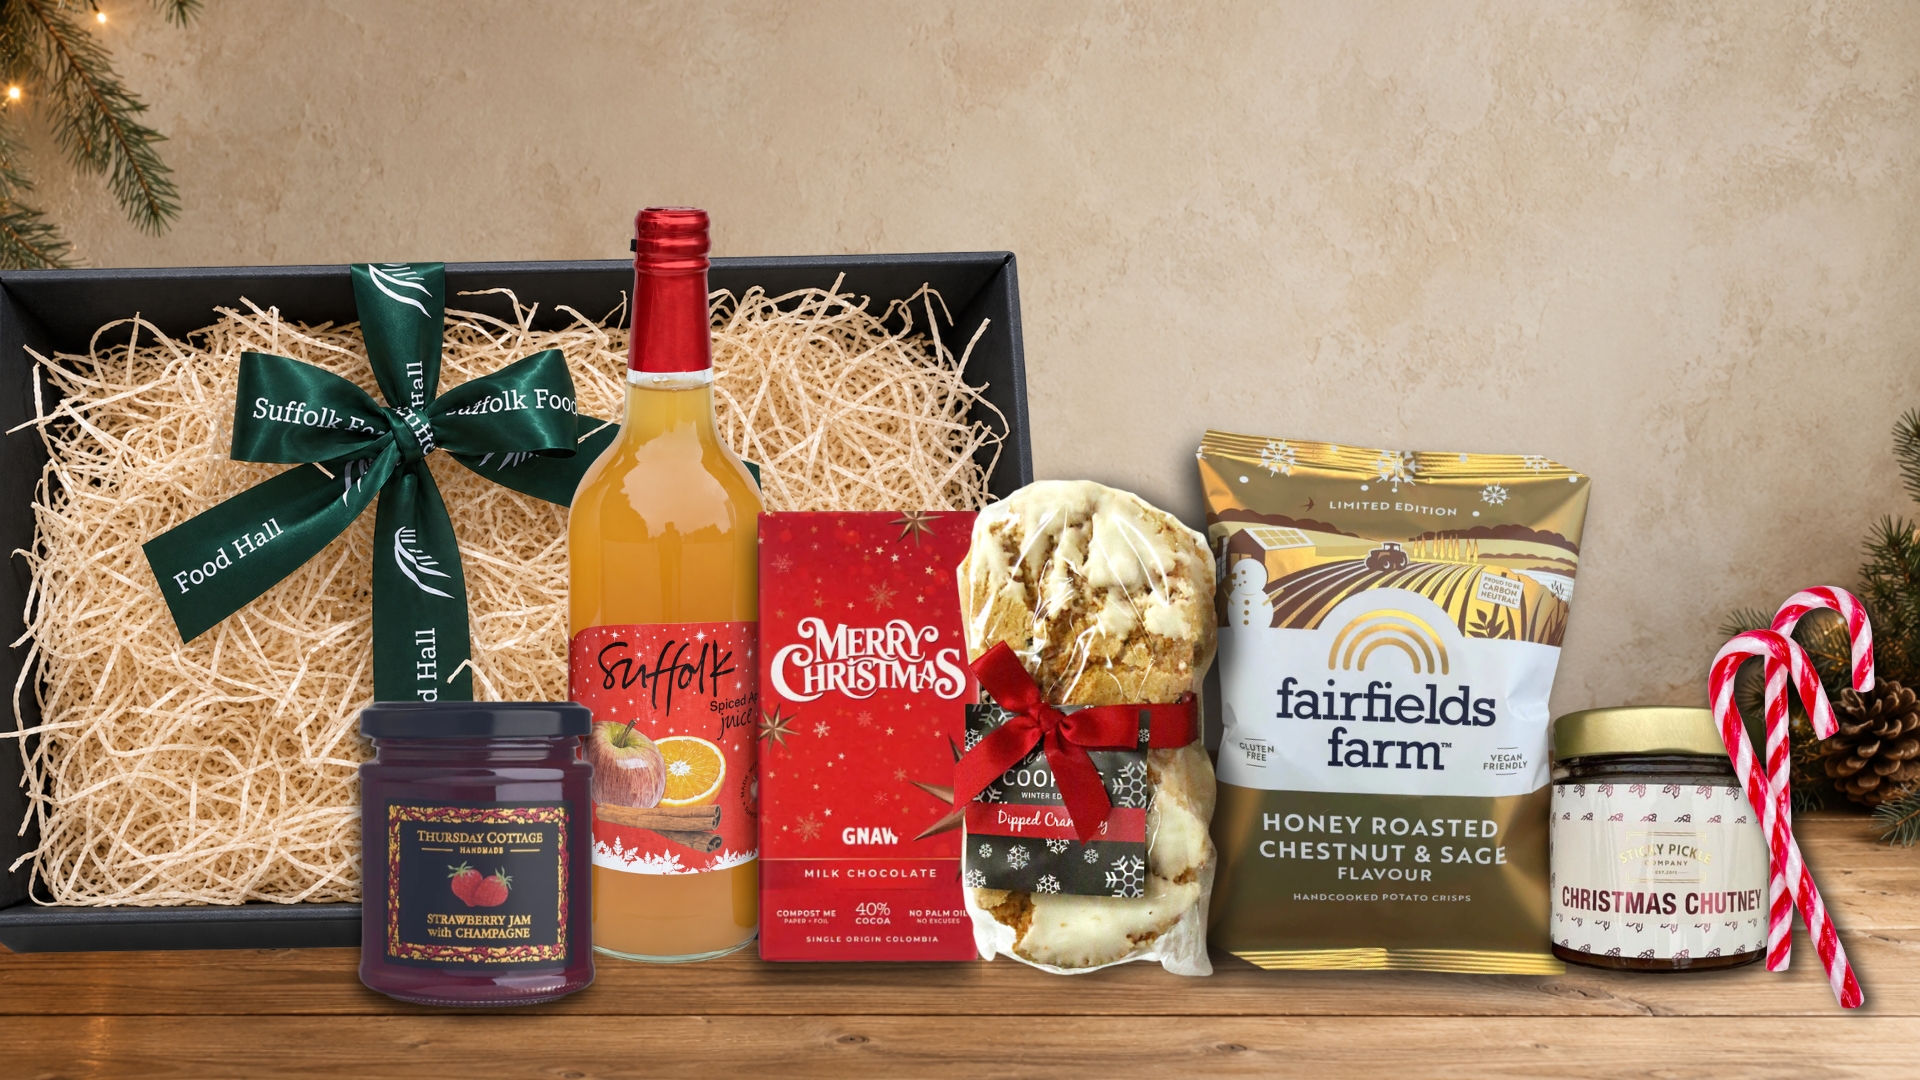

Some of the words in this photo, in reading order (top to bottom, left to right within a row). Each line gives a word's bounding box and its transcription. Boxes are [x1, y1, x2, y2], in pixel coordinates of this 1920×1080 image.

[446, 389, 528, 416] uffolk
[253, 398, 342, 429] Suffolk
[1329, 501, 1390, 510] LIMITED
[1395, 502, 1457, 516] EDITION
[173, 547, 233, 594] Food
[231, 518, 284, 559] Hall
[1484, 576, 1504, 585] PROUD
[1482, 582, 1518, 597] CARBON
[797, 617, 939, 663] MERRY
[415, 628, 437, 680] Hall
[770, 648, 967, 702] CHRISTMAS
[710, 694, 746, 713] Spiced
[1276, 677, 1497, 727] fairfields
[717, 708, 752, 740] juice
[1239, 742, 1275, 753] GLUTEN
[1327, 726, 1445, 771] farm
[1246, 751, 1267, 761] FREE
[1490, 753, 1523, 762] VEGAN
[1483, 761, 1528, 770] FRIENDLY
[1021, 791, 1050, 799] WINTER
[998, 809, 1041, 833] Dipped
[1263, 813, 1362, 834] HONEY
[1372, 817, 1498, 838] ROASTED
[417, 830, 485, 843] THURSDAY
[486, 831, 543, 844] COTTAGE
[842, 827, 899, 845] GNAW
[1259, 841, 1405, 862] CHESTNUT
[1414, 845, 1431, 863] &
[1440, 846, 1507, 865] SAGE
[1619, 843, 1664, 865] STICKY
[1668, 843, 1713, 866] PICKLE
[804, 869, 840, 878] MILK
[847, 869, 937, 878] CHOCOLATE
[1338, 867, 1432, 882] FLAVOUR
[1293, 893, 1379, 901] HANDCOOKED
[1382, 893, 1428, 902] POTATO
[1432, 894, 1471, 902] CRISPS
[1562, 886, 1677, 915] CHRISTMAS
[1685, 888, 1762, 915] CHUTNEY
[855, 902, 891, 916] 40%
[953, 909, 968, 917] OIL
[427, 914, 506, 926] STRAWBERRY
[508, 915, 532, 928] JAM
[855, 917, 891, 925] COCOA
[428, 927, 452, 938] with
[455, 928, 530, 939] CHAMPAGNE
